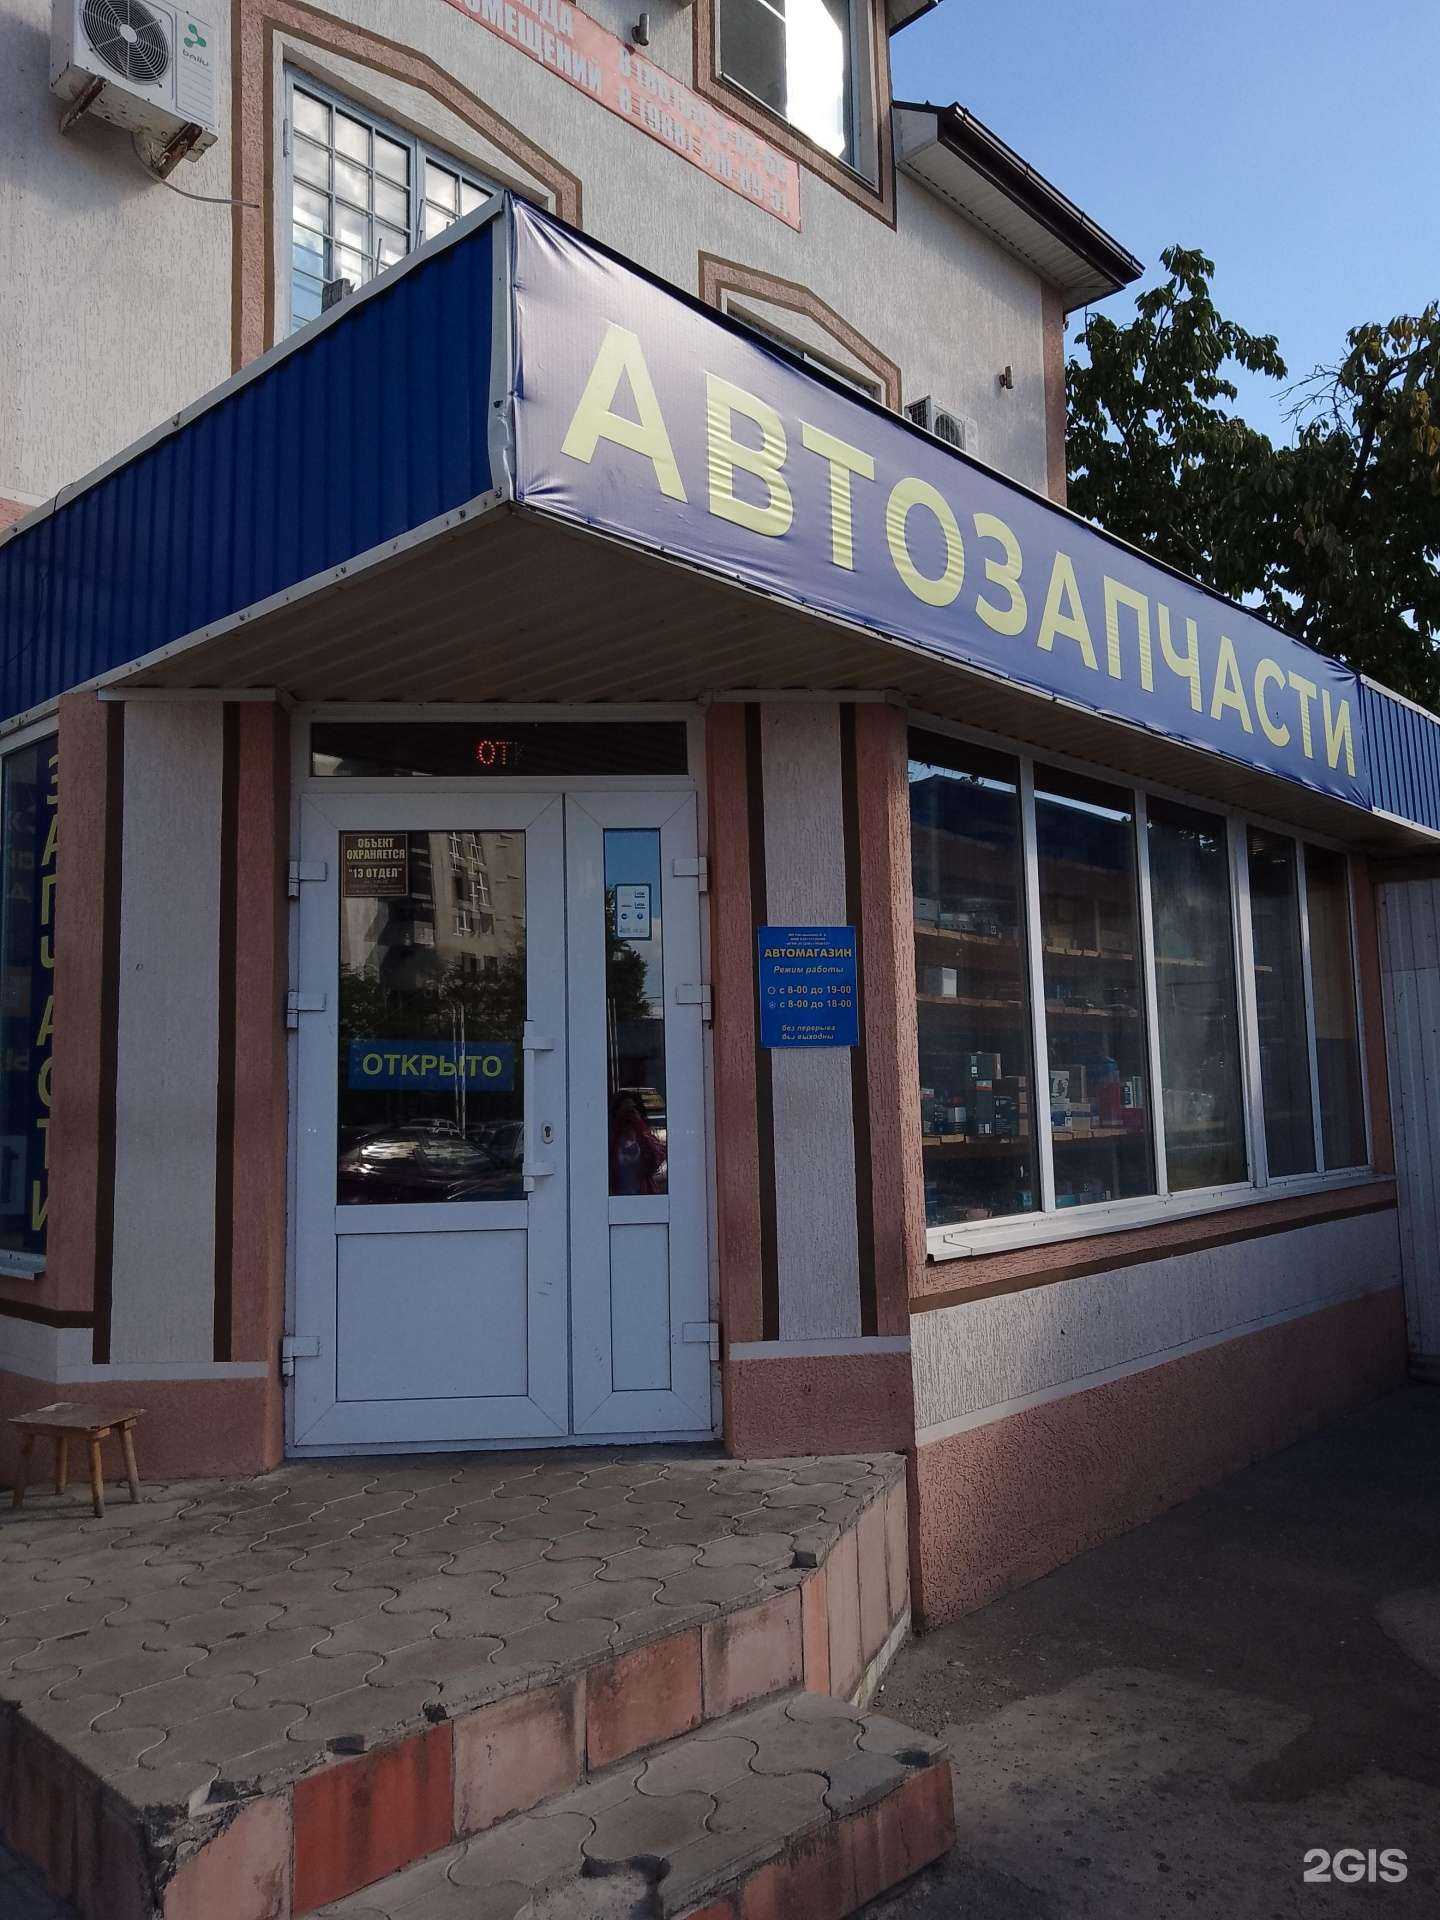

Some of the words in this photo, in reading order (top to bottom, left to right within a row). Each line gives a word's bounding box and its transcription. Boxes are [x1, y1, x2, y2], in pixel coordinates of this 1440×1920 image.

[560, 322, 1358, 777] АВТОЗАПЧАСТИ
[357, 838, 394, 848] ОБЪЕКТ
[346, 849, 405, 860] ОХРАНЯЕТСЯ
[764, 948, 852, 958] АВТОМАГАЗИН
[773, 965, 804, 974] Режим
[805, 964, 844, 975] работы
[787, 985, 808, 994] 8-00
[810, 987, 824, 995] до
[827, 985, 852, 994] 19-00
[787, 1000, 808, 1008] 8-00
[810, 1001, 824, 1009] до
[827, 999, 852, 1008] 18-00
[362, 1053, 502, 1077] ОТКРЫТО
